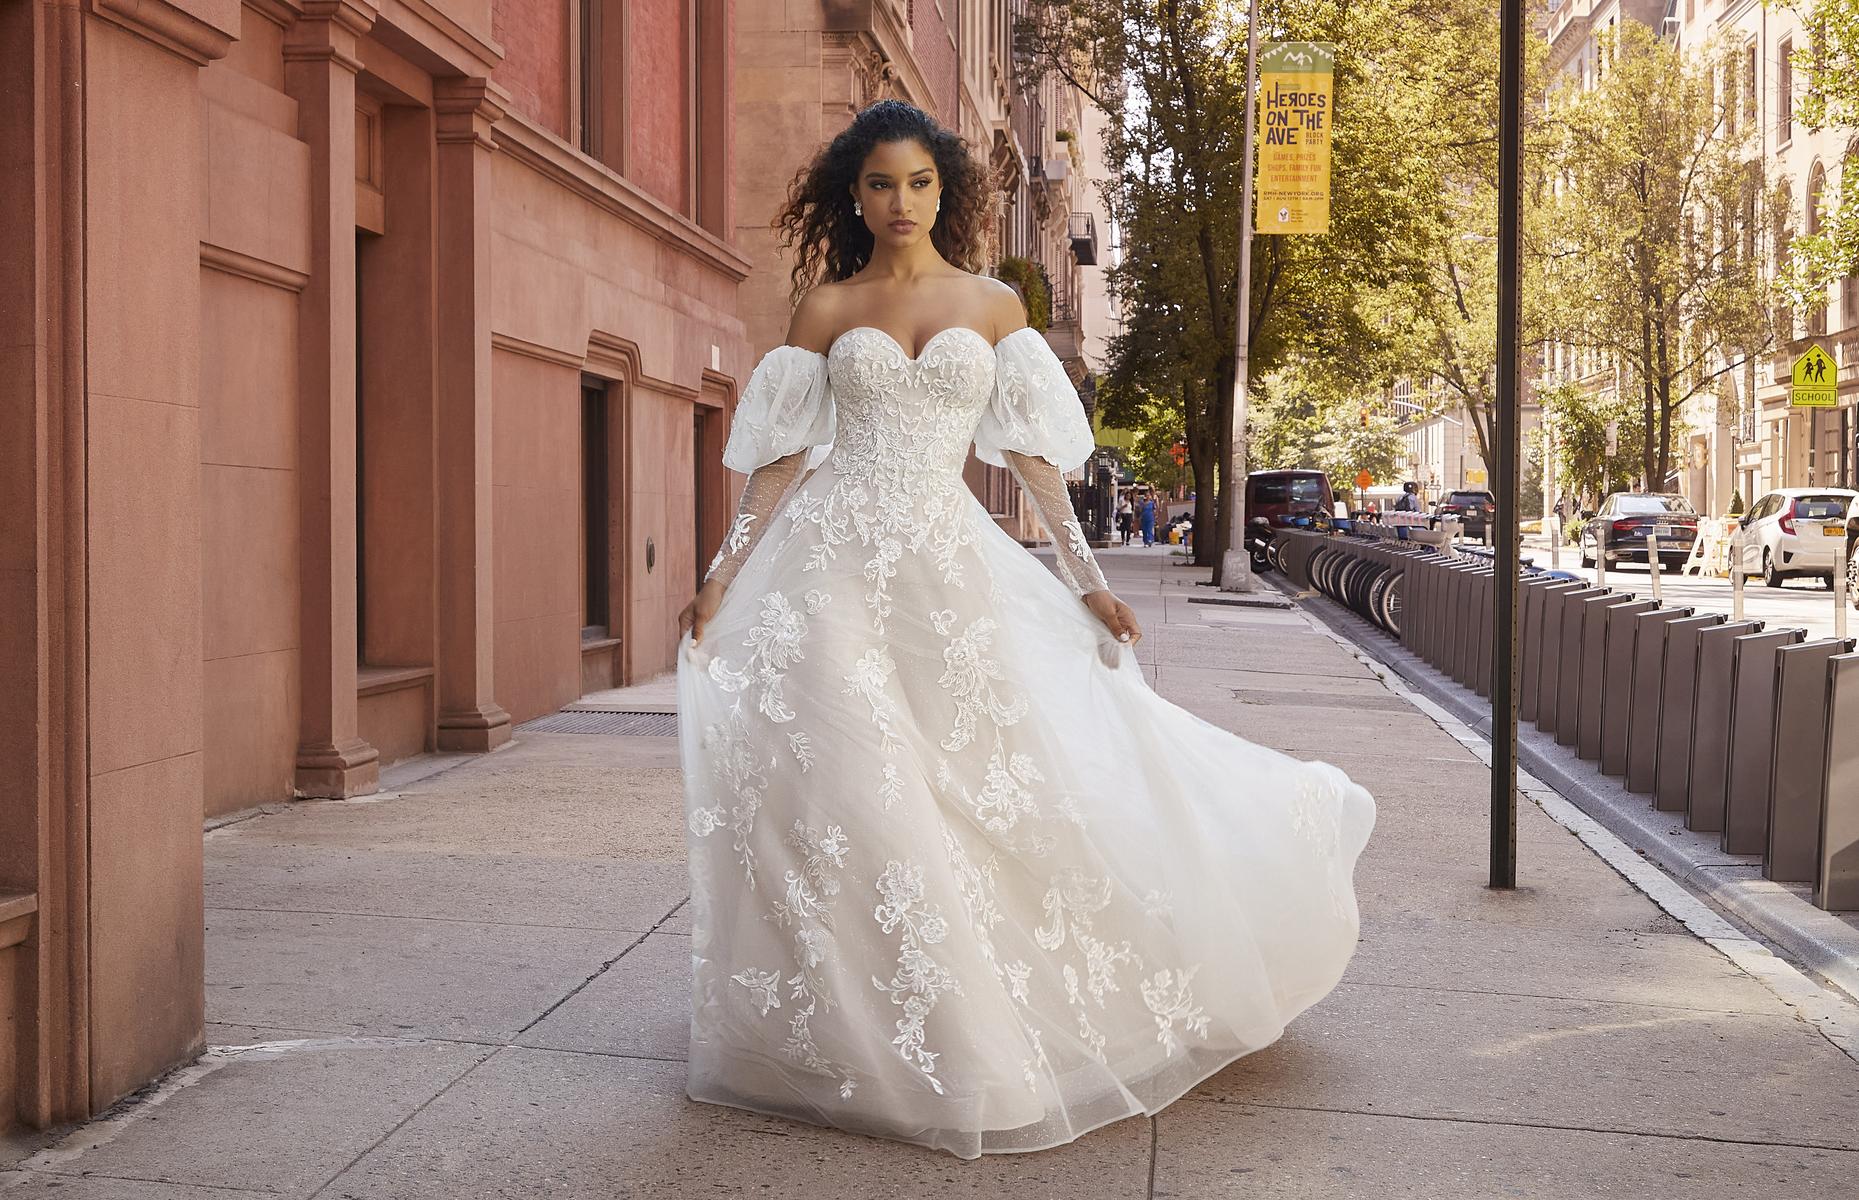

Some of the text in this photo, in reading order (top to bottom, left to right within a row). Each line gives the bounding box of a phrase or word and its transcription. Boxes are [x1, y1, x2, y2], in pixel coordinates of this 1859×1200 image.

[1267, 81, 1326, 109] HEROES
[1266, 110, 1325, 131] ON THE
[1266, 127, 1299, 146] AVE
[1270, 175, 1318, 183] ENTERTAINMENT
[1795, 392, 1834, 401] SCHOOL
